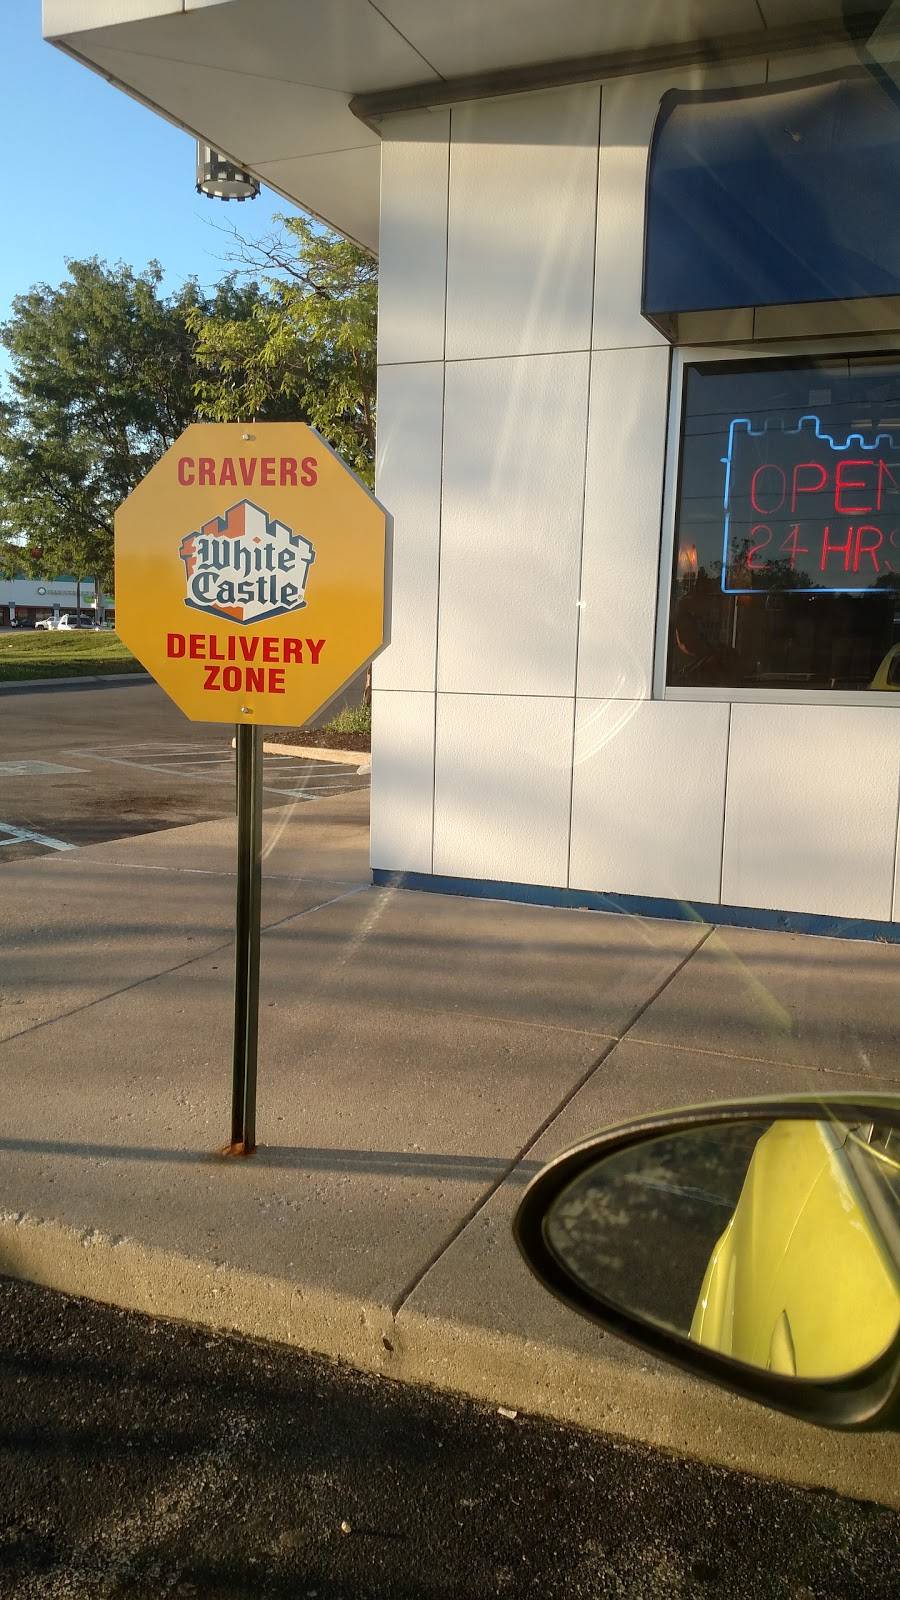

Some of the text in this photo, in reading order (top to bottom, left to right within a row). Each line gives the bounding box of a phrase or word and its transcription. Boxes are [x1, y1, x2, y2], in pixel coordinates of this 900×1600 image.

[177, 457, 319, 487] CRAVERS
[197, 538, 296, 578] White
[747, 523, 809, 571] 24
[191, 571, 299, 606] Castle
[166, 633, 326, 664] DELIVERY
[203, 665, 286, 694] ZONE
